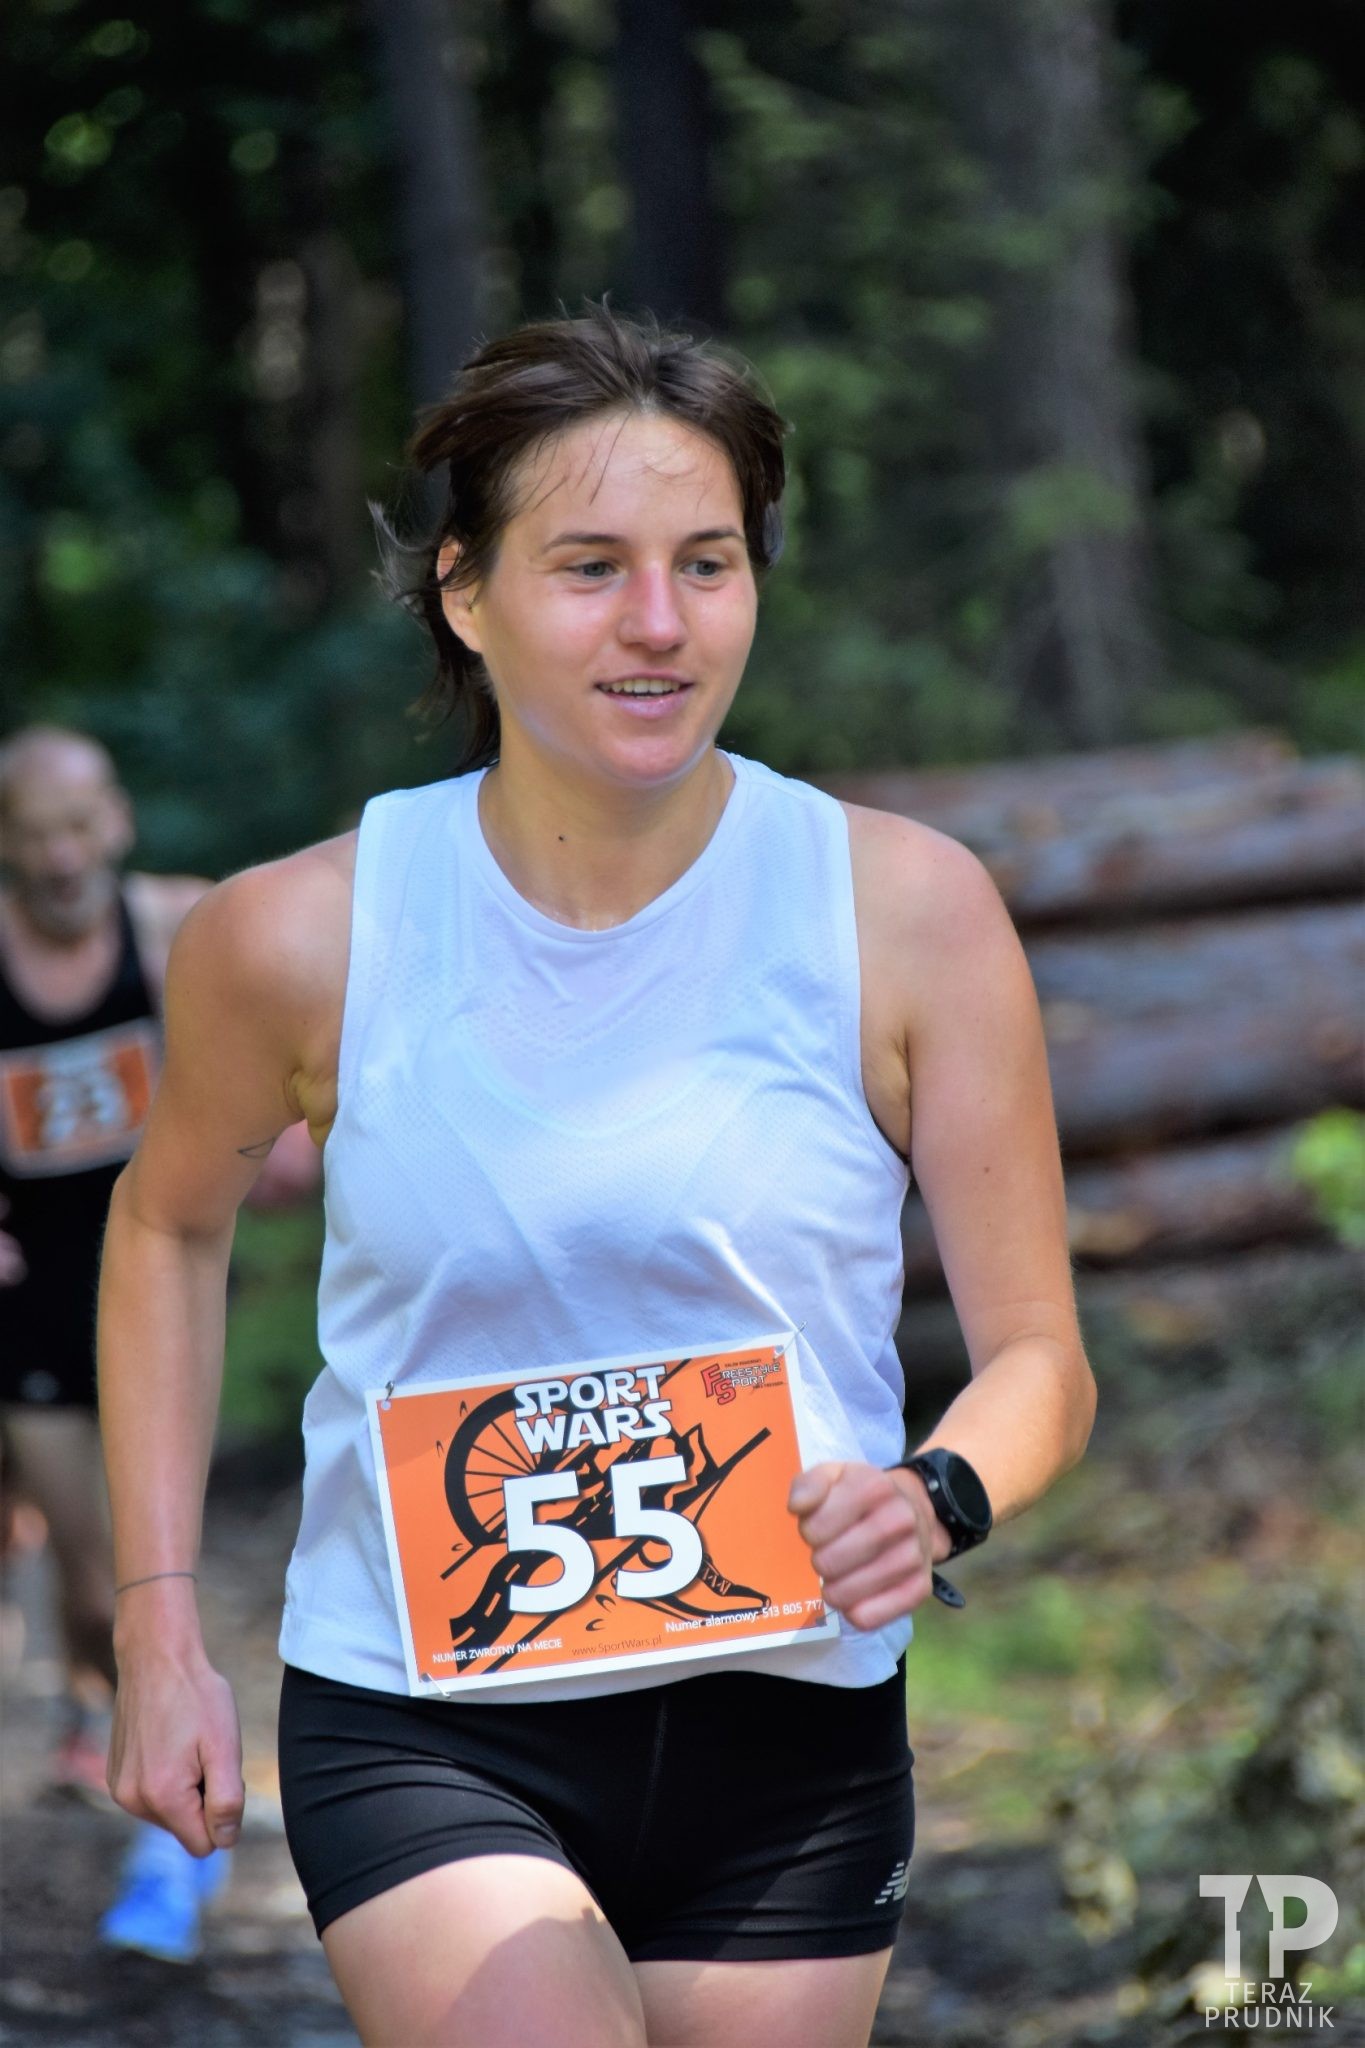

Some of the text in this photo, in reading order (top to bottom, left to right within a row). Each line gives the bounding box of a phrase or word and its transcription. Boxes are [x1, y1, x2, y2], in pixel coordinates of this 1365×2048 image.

[514, 1364, 667, 1419] SPORT
[514, 1399, 673, 1454] WARS
[502, 1454, 703, 1614] 55
[665, 1617, 702, 1633] Numer
[762, 1604, 780, 1619] 513
[782, 1602, 802, 1616] 805
[432, 1638, 563, 1664] NUMER ZWROTNY NA MECIE
[571, 1634, 663, 1657] www.SportWars.pl
